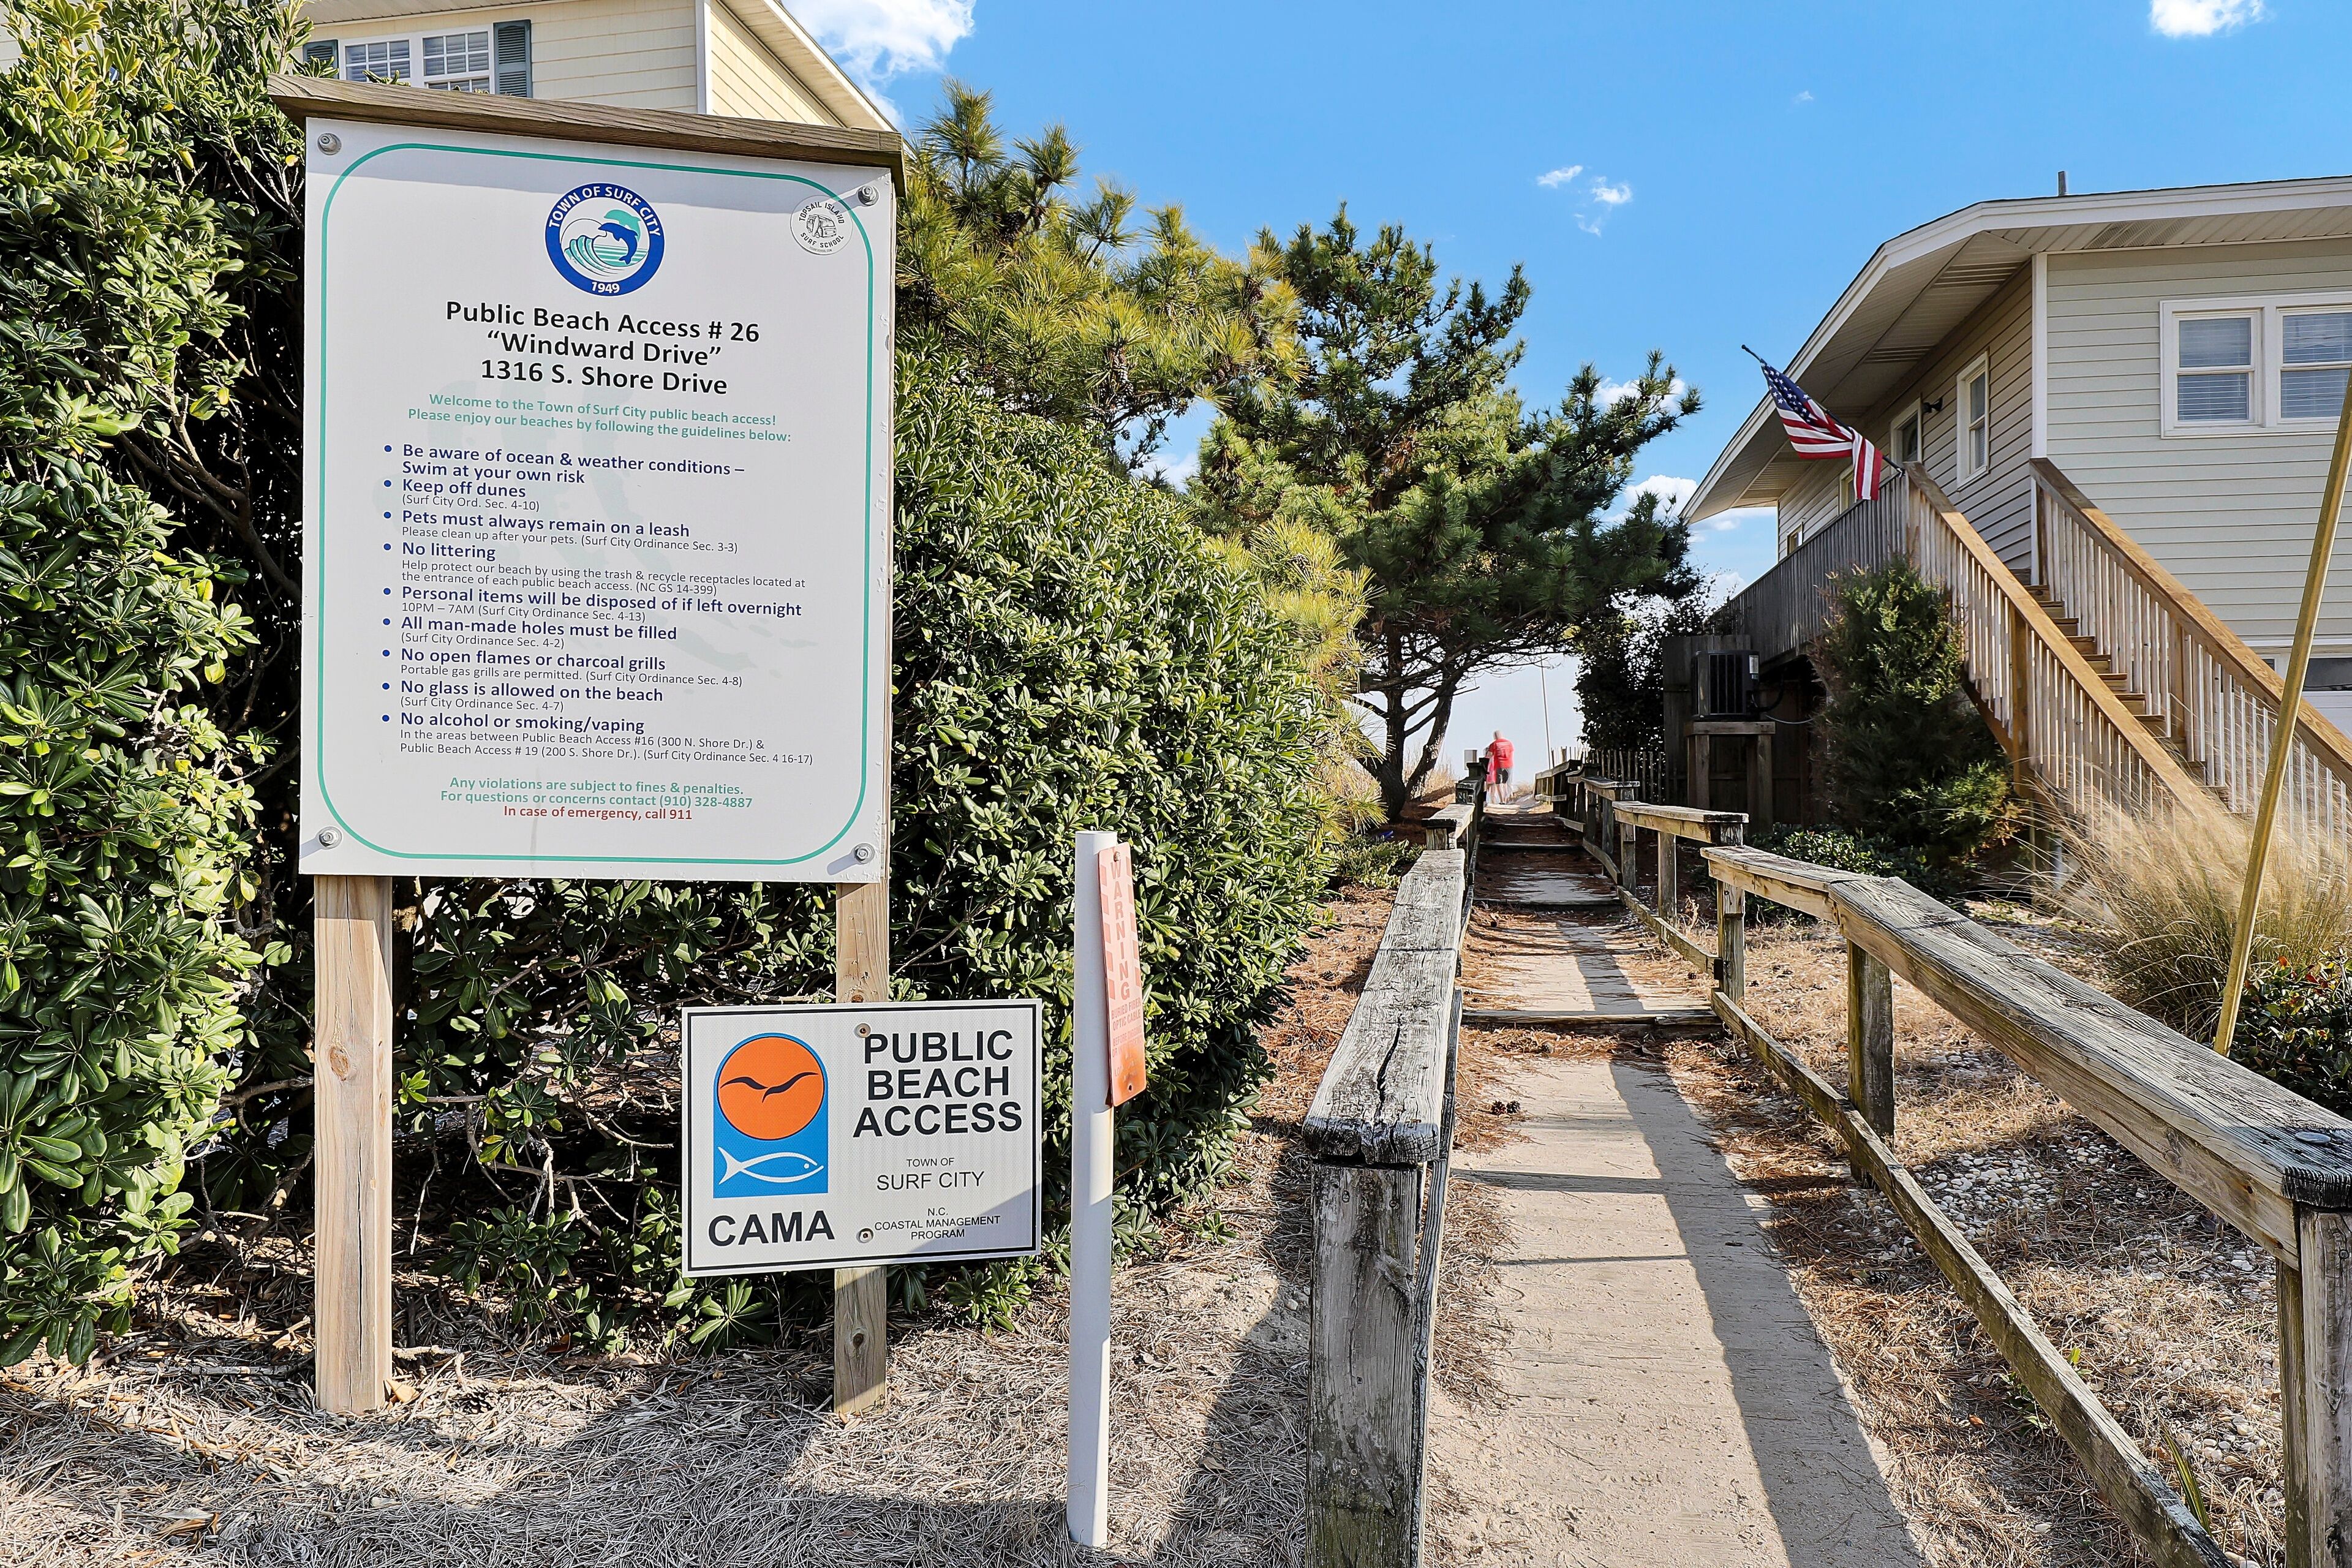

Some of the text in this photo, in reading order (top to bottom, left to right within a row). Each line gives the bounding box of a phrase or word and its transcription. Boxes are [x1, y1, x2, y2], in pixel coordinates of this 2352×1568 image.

[549, 186, 661, 236] TOWN OF SURF CITY
[799, 202, 821, 221] TOPSAIL
[801, 233, 843, 247] SURF SCHOOL
[592, 282, 620, 293] 1949
[447, 301, 759, 342] Public Beach Access # 26
[482, 360, 727, 394] 1316 S. Shore Drive
[429, 394, 775, 426] Welcome to the Town of Surf City public beach access!
[409, 408, 791, 442] Please enjoy our beaches by following the guidelines below:
[404, 444, 730, 475] Be aware of ocean & weather conditions
[402, 461, 585, 483] Swim at your own risk
[403, 478, 526, 497] Keep off dunes
[402, 494, 539, 513] (Surf City Ord. Sec. 4-10)
[403, 510, 689, 537] Pets must always remain on a leash
[402, 526, 737, 554] Please clean up after your pets. (Surf City Ordinance Sec. 3-3)
[403, 542, 496, 562] No littering
[402, 586, 802, 618] Personal items will be disposed of if left overnight
[401, 616, 676, 640] All man-made holes must be filled
[402, 648, 665, 672] No open flames or charcoal grills
[401, 680, 663, 701] No glass is allowed on the beach
[401, 712, 644, 735] No alcohol or smoking/vaping
[450, 777, 743, 796] Any violations are subject to fines & penalties.
[441, 791, 462, 801] For
[466, 791, 528, 804] questions
[549, 796, 606, 804] concerns
[609, 796, 657, 805] contact
[660, 794, 691, 809] (910)
[695, 796, 752, 808] 328-4887
[504, 805, 692, 821] In case of emergency, call 911
[1110, 861, 1129, 1000] WARNING
[1112, 1005, 1128, 1019] BURIED
[1113, 1016, 1126, 1030] OPTIC
[864, 1030, 1013, 1064] PUBLIC
[868, 1066, 1009, 1100] BEACH
[853, 1102, 1022, 1137] ACCESS
[907, 1158, 955, 1167] TOWN OF
[876, 1172, 984, 1191] SURF CITY
[927, 1208, 949, 1216] N.C.
[708, 1210, 835, 1247] CAMA
[875, 1216, 1000, 1231] COASTAL MANAGEMENT
[911, 1229, 965, 1240] PROGRAM
